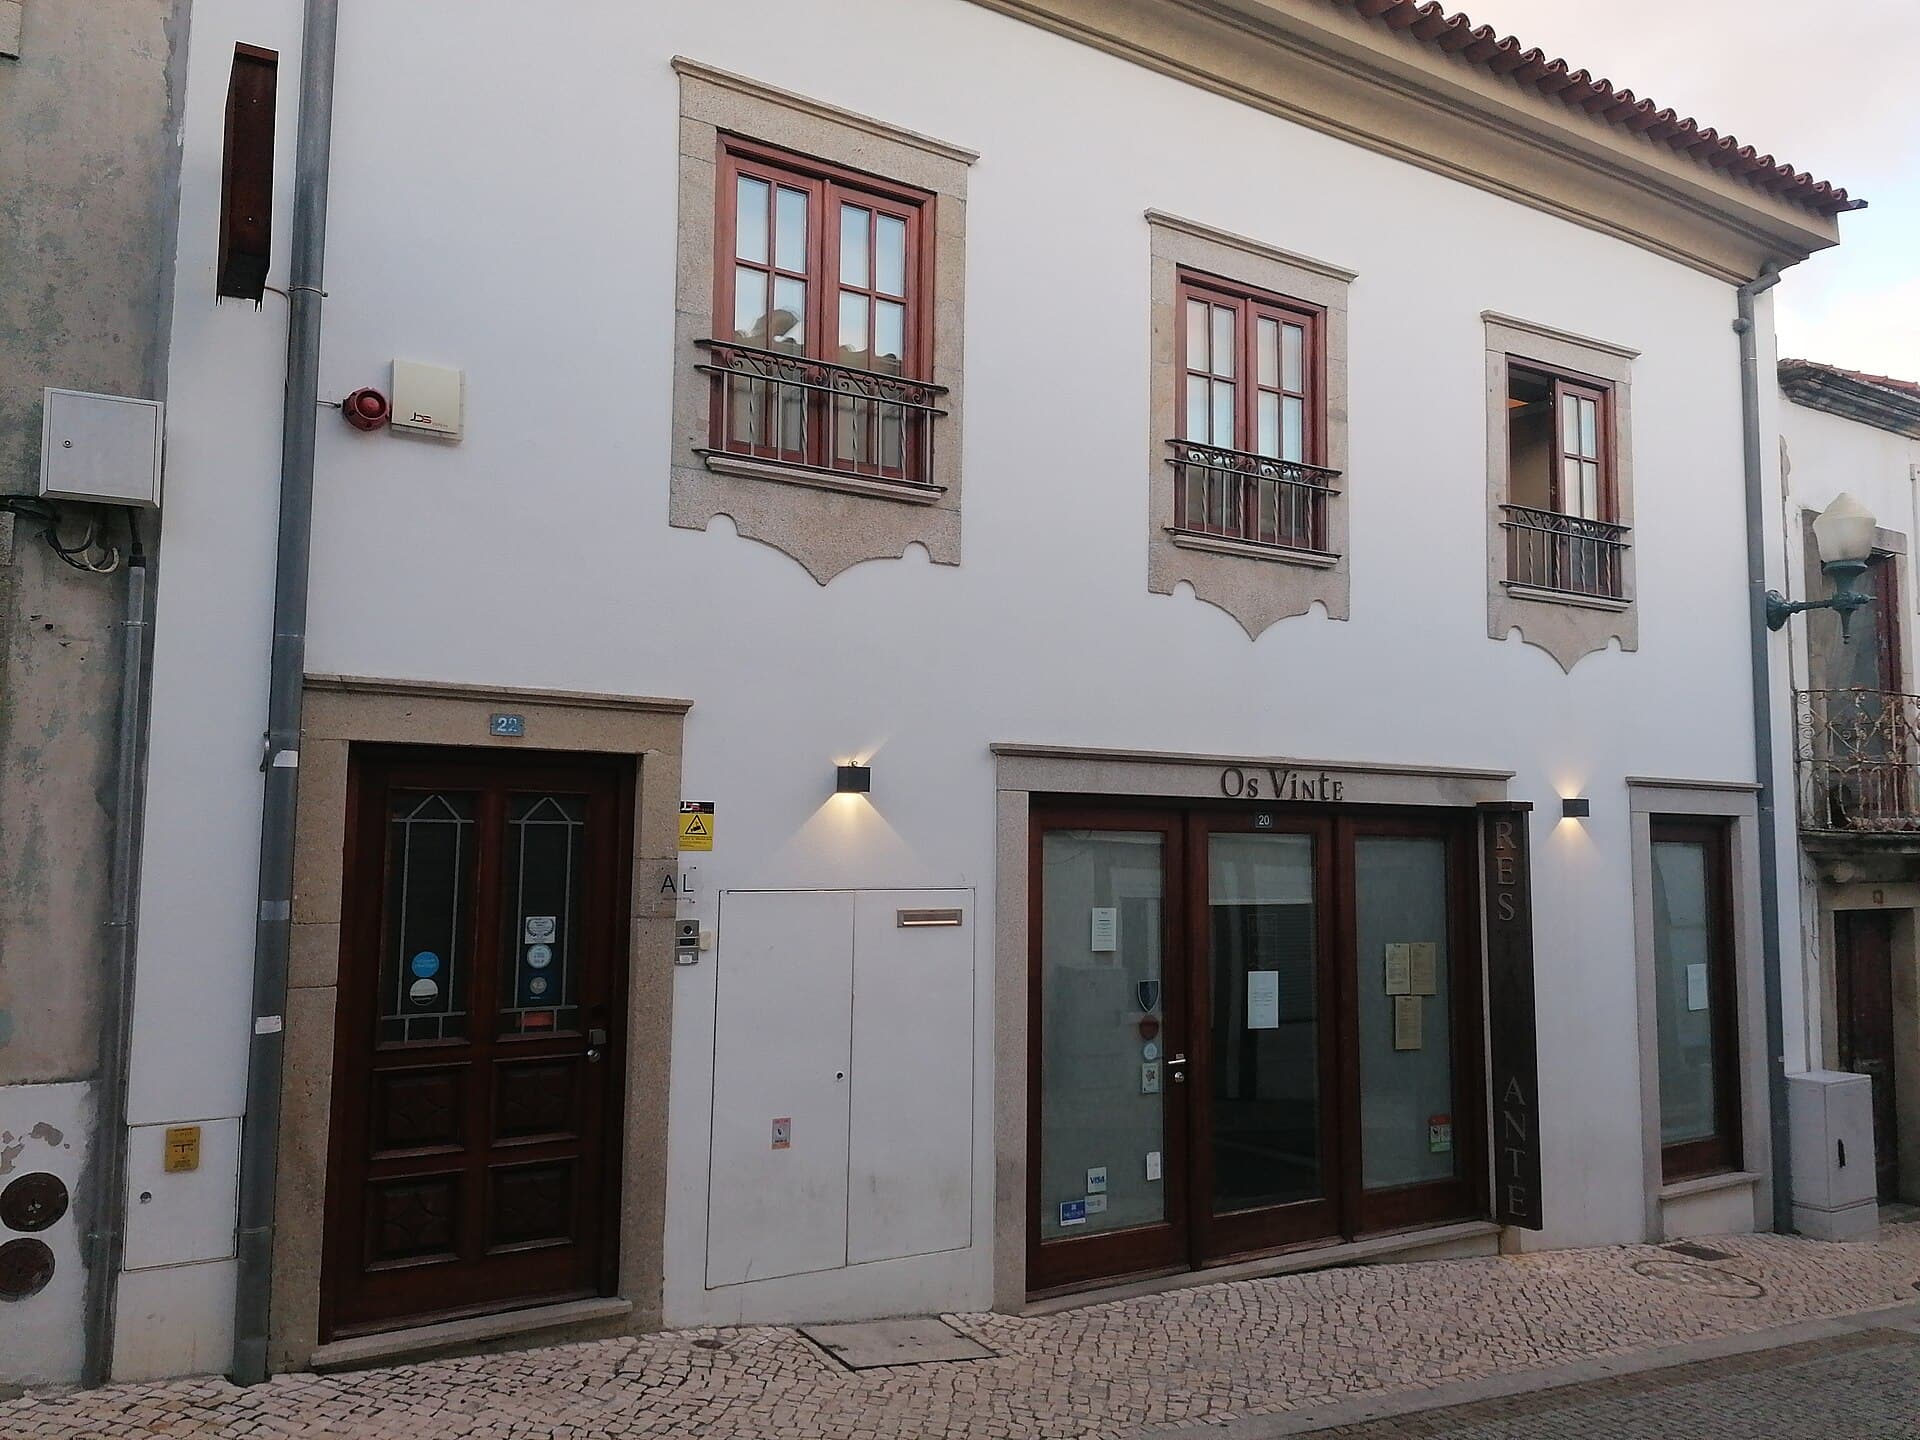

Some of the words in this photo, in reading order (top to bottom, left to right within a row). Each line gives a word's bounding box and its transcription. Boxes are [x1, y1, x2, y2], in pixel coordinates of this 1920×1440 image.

[1221, 767, 1258, 798] Os
[1258, 815, 1270, 825] 20
[660, 873, 695, 893] AL
[1495, 821, 1527, 1217] RESANTE
[1090, 1175, 1105, 1185] VISA
